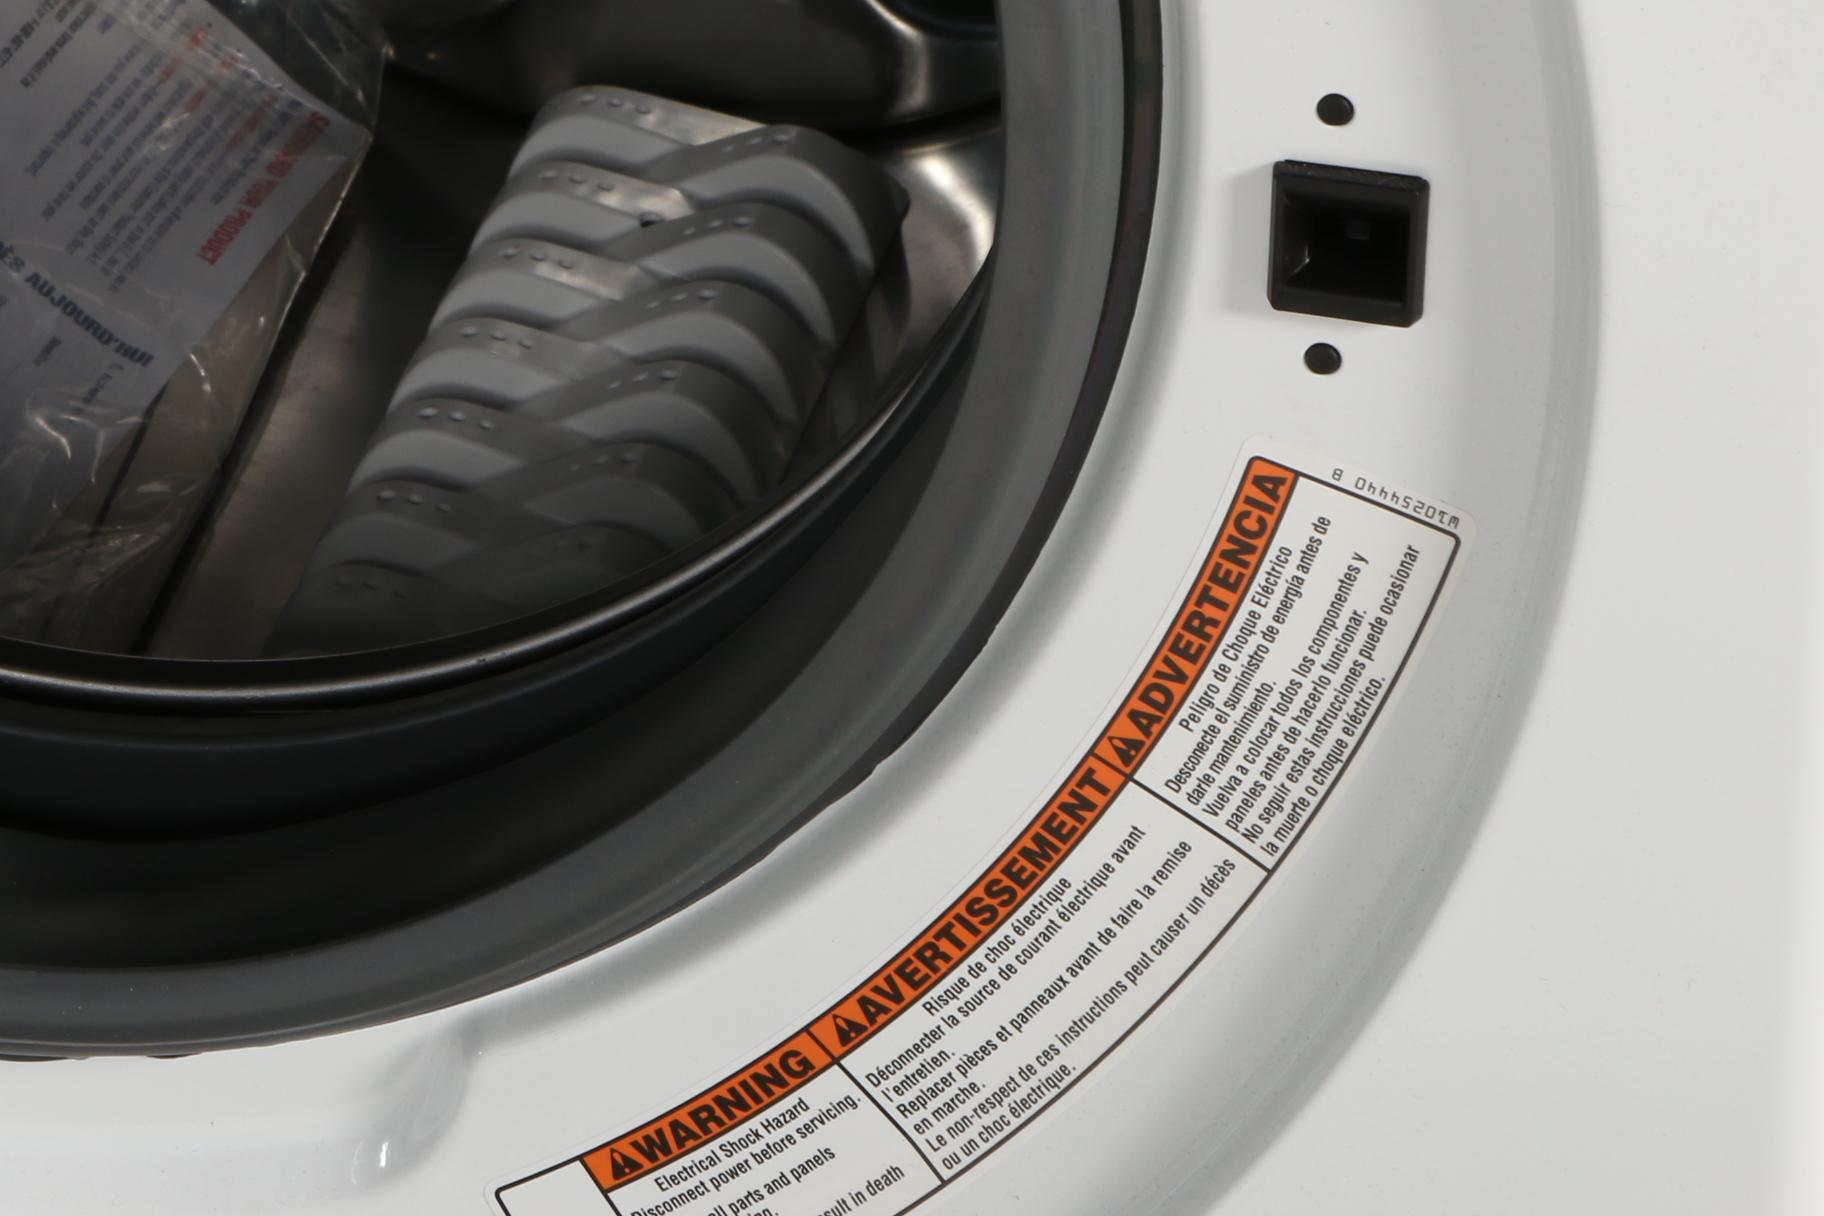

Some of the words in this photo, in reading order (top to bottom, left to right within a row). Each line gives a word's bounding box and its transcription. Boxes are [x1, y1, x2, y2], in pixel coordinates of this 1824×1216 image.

[26, 273, 154, 368] AUJOURD'HUI
[1354, 477, 1460, 529] W10254440
[1250, 546, 1292, 608] Eléctrico
[1351, 552, 1369, 564] y
[1127, 475, 1286, 739] ADVERTENCIA
[1221, 609, 1262, 662] Choque
[1307, 564, 1361, 655] componentes
[1164, 724, 1221, 794] Desconecte
[1214, 707, 1231, 724] el
[1223, 643, 1270, 711] suministro
[1260, 624, 1280, 643] de
[1271, 574, 1305, 625] energía
[1296, 535, 1322, 574] antes
[1311, 516, 1331, 535] de
[1212, 663, 1232, 683] de
[1291, 655, 1316, 678] los
[1178, 683, 1220, 733] Peligro
[1270, 678, 1303, 717] todos
[1185, 773, 1216, 806] darle
[1208, 681, 1276, 775] mantenimiento.
[1235, 764, 1250, 776] a
[1242, 715, 1280, 764] colocar
[1201, 775, 1243, 817] Vuelva
[860, 768, 1110, 1026] AVERTISSEMENT
[864, 1024, 946, 1088] Déconnecter
[940, 1014, 960, 1029] la
[956, 978, 1001, 1018] source
[997, 963, 1018, 981] de
[1014, 918, 1062, 965] courant
[1055, 862, 1115, 922] électrique
[1111, 825, 1146, 863] avant
[921, 976, 970, 1017] Risque
[967, 961, 987, 979] de
[984, 934, 1016, 964] choc
[1010, 877, 1072, 937] électrique
[629, 1050, 815, 1161] WARNING
[880, 1050, 955, 1103] l'entretien.
[653, 1149, 722, 1192] Electrical
[718, 1127, 765, 1158] Shock
[759, 1097, 810, 1135] Hazard
[708, 1158, 752, 1192] power
[749, 1133, 797, 1165] before
[795, 1094, 861, 1139] servicing.
[727, 1189, 765, 1216] parts
[763, 1171, 791, 1195] and
[789, 1147, 835, 1183] panels
[848, 1190, 867, 1206] in
[865, 1165, 905, 1196] death
